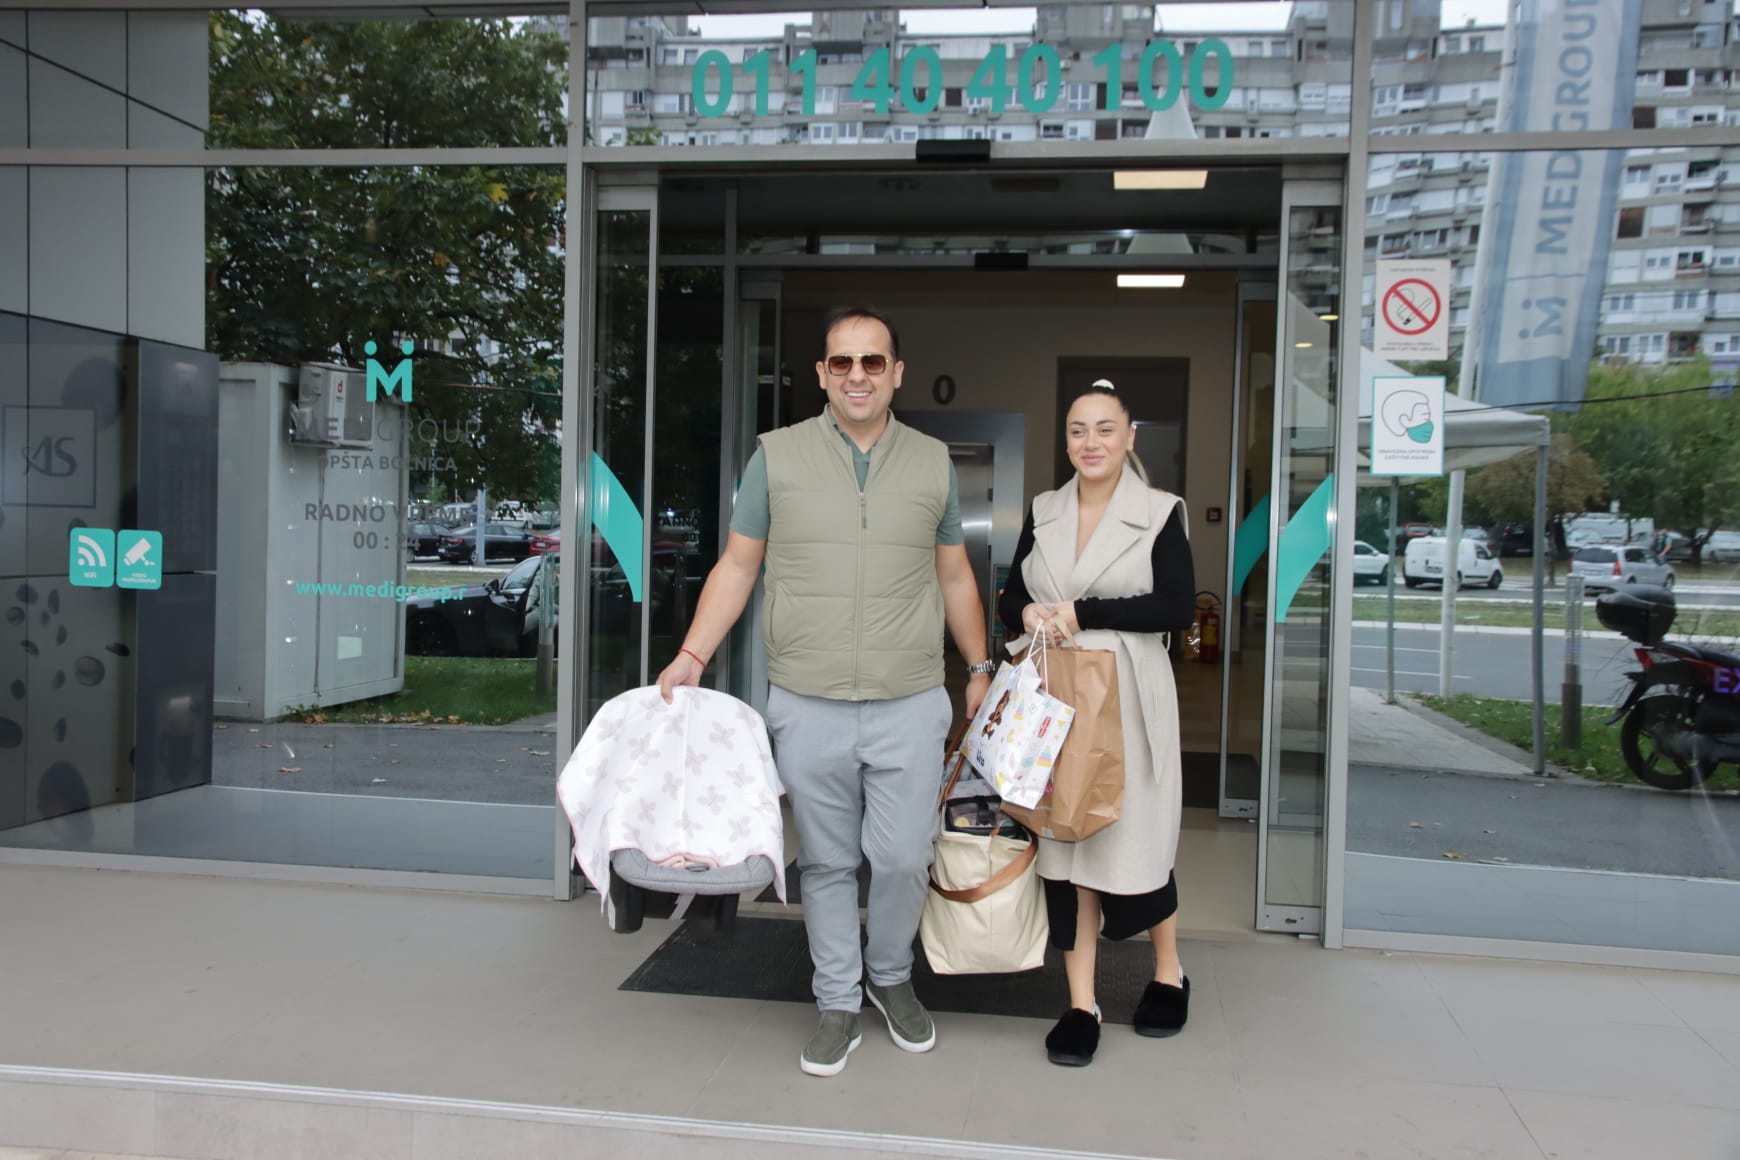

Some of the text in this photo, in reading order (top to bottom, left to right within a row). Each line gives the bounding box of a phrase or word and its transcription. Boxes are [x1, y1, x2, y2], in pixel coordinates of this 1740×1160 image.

[691, 38, 1234, 118] 011 40 40 100
[932, 374, 955, 405] 0
[305, 503, 386, 523] RADNO
